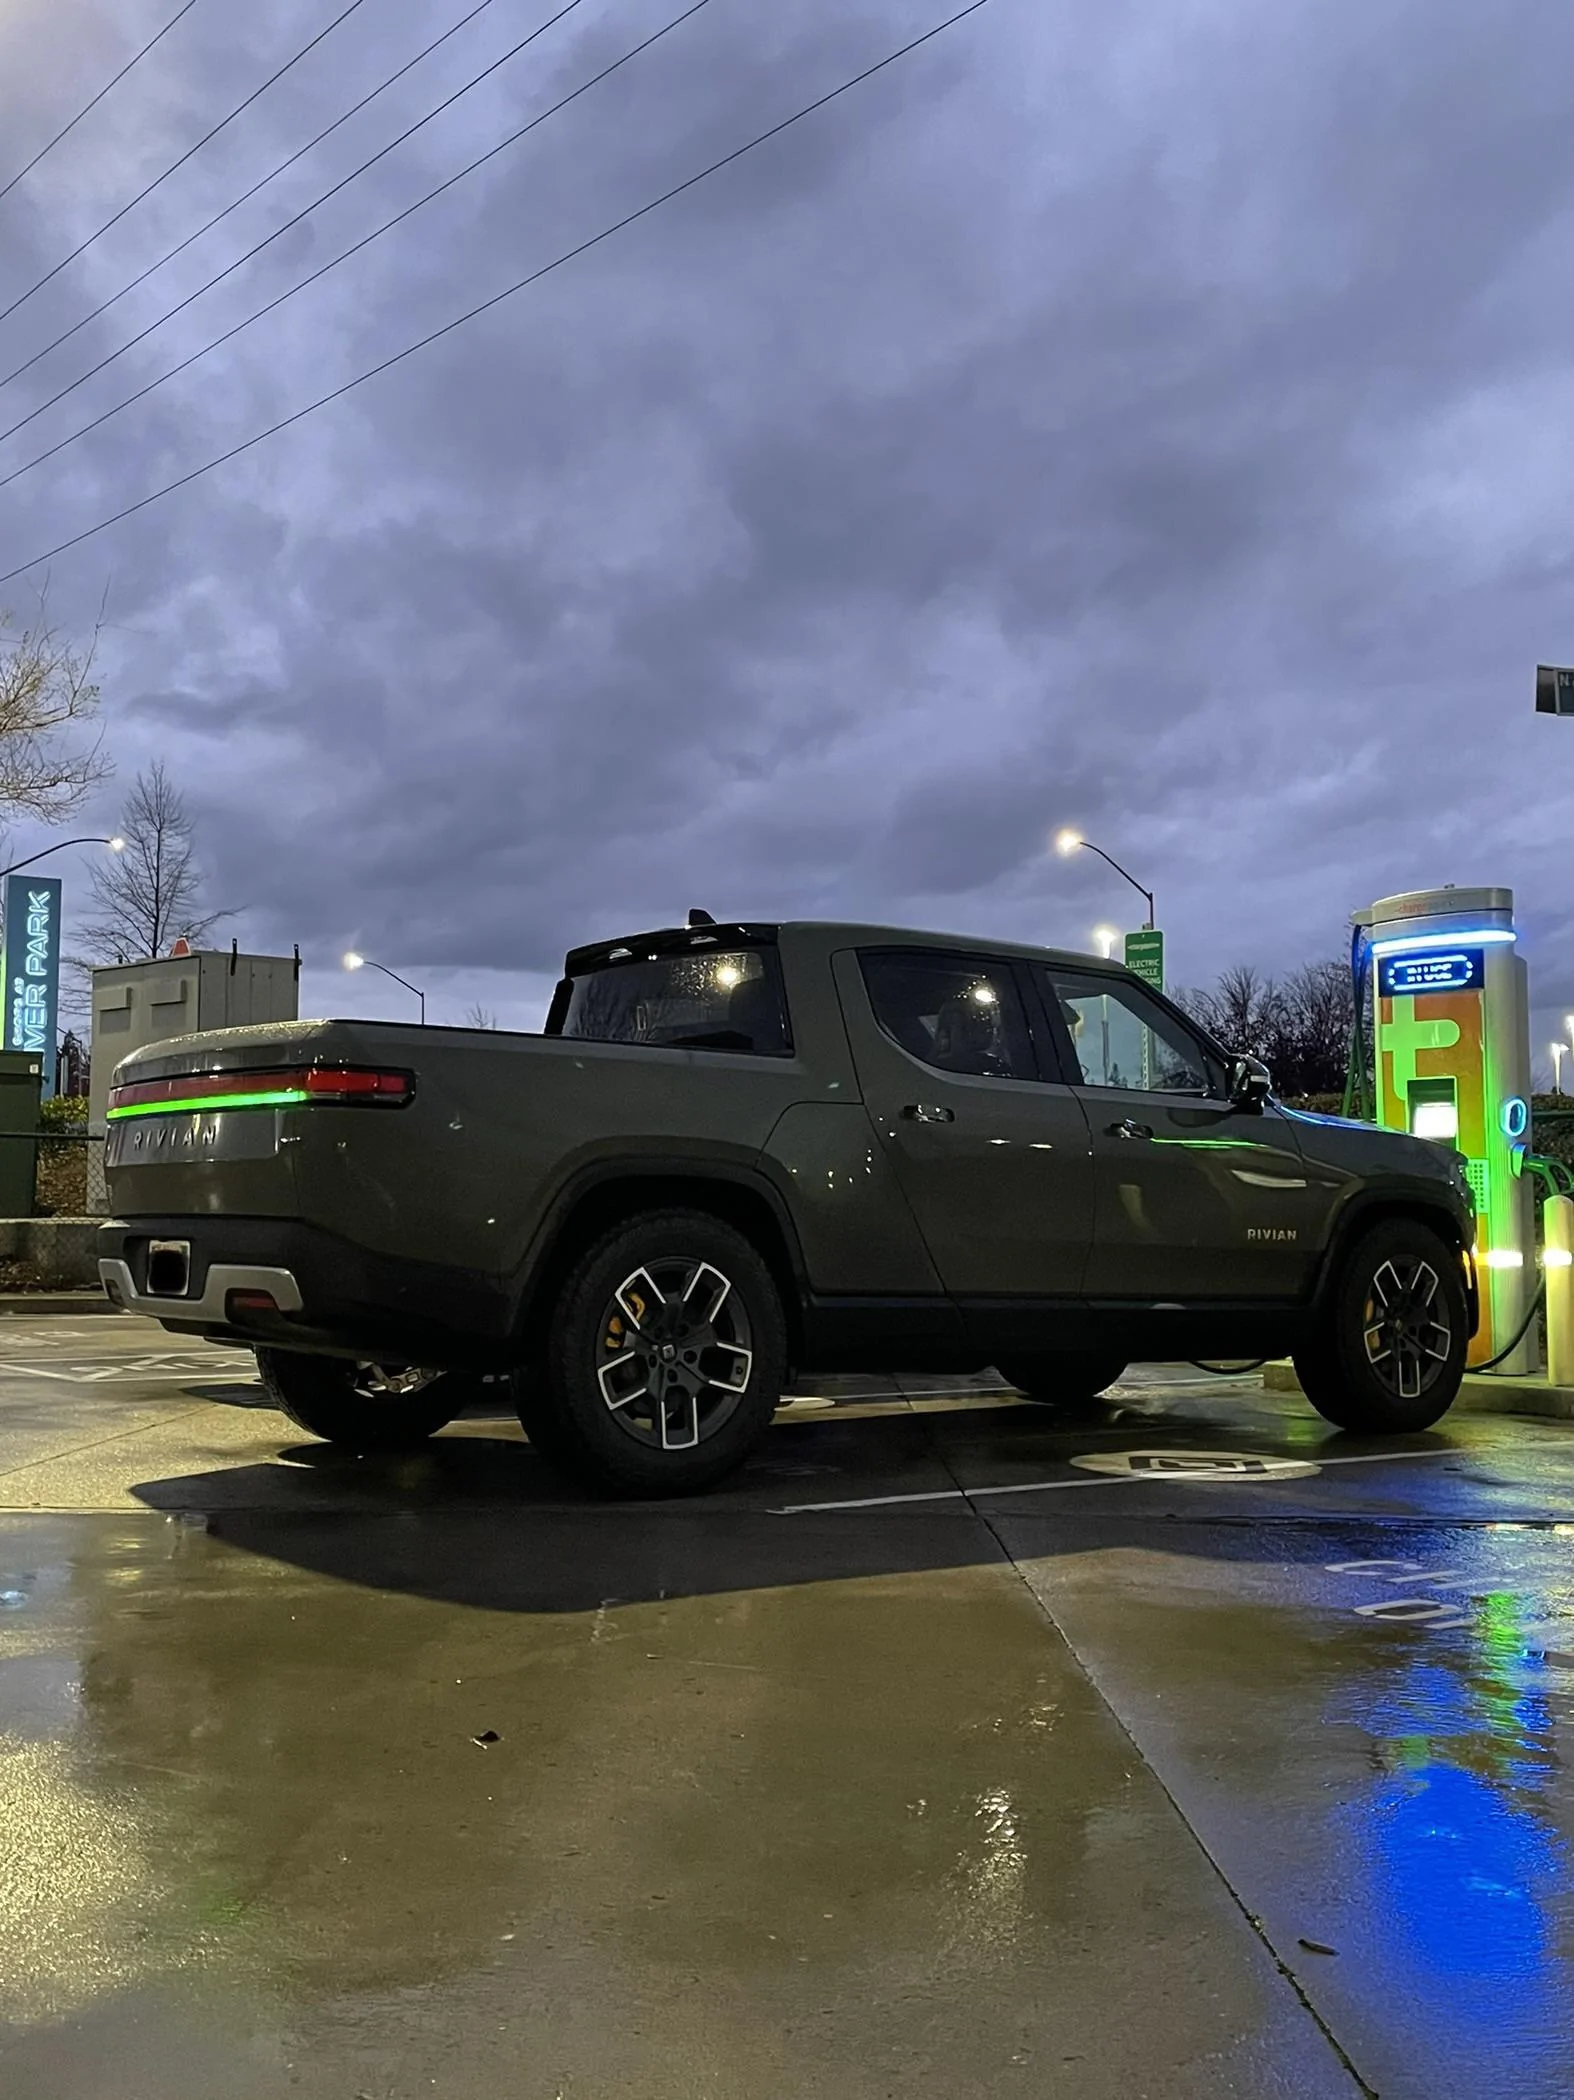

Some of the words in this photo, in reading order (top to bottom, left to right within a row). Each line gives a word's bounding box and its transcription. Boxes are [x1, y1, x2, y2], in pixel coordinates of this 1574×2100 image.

[25, 890, 51, 976] PARK
[1129, 959, 1160, 969] ELECTRIC
[133, 1125, 217, 1150] RIVIAN
[1247, 1228, 1297, 1240] RIVIAN
